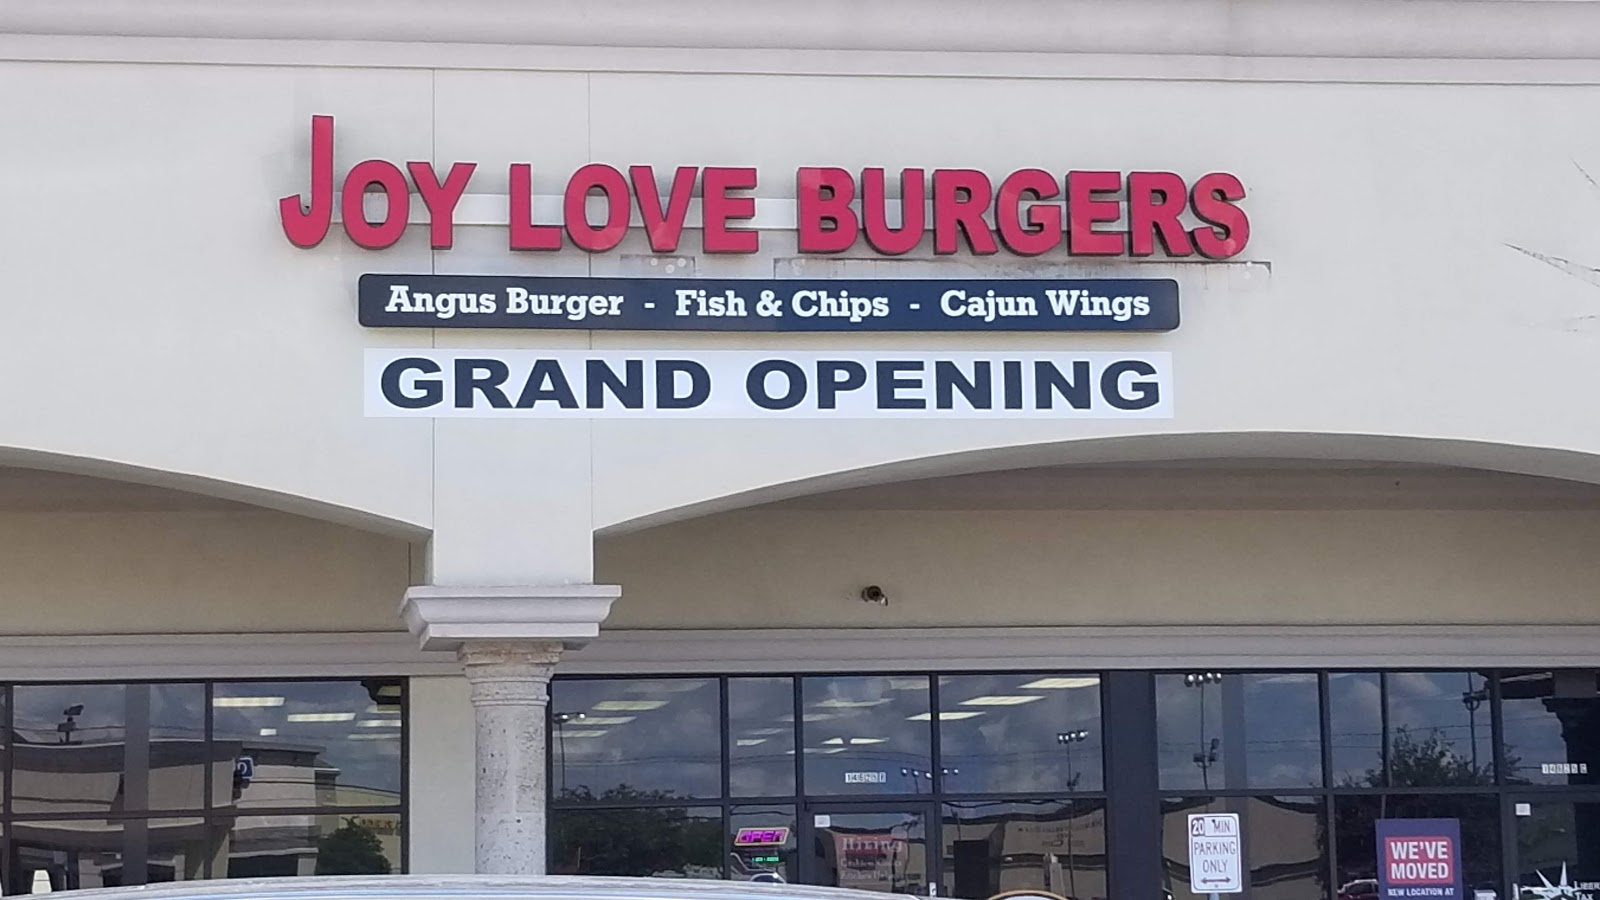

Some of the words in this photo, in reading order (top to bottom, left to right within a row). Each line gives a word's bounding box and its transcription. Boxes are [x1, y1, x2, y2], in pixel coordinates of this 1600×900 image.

[280, 115, 477, 250] JOY
[509, 163, 759, 253] LOVE
[797, 167, 1250, 260] BURGERS
[385, 285, 497, 319] Angus
[506, 287, 624, 321] Burger
[675, 290, 748, 316] Fish
[756, 290, 783, 317] &
[791, 290, 889, 322] Chips
[940, 289, 1038, 322] Cajun
[1045, 290, 1150, 321] Wings
[380, 357, 712, 410] GRAND
[746, 359, 1160, 411] OPENING
[738, 829, 785, 843] OPEN
[1192, 819, 1205, 836] 20
[1212, 820, 1231, 833] MIN
[842, 837, 903, 853] Hiring
[1194, 841, 1236, 855] PARKING
[1390, 841, 1449, 860] WE'VE
[1203, 859, 1228, 873] ONLY
[1391, 862, 1449, 880] MOVED
[1388, 888, 1405, 896] NEW
[1406, 888, 1443, 896] LOCATION
[1445, 887, 1454, 896] AT
